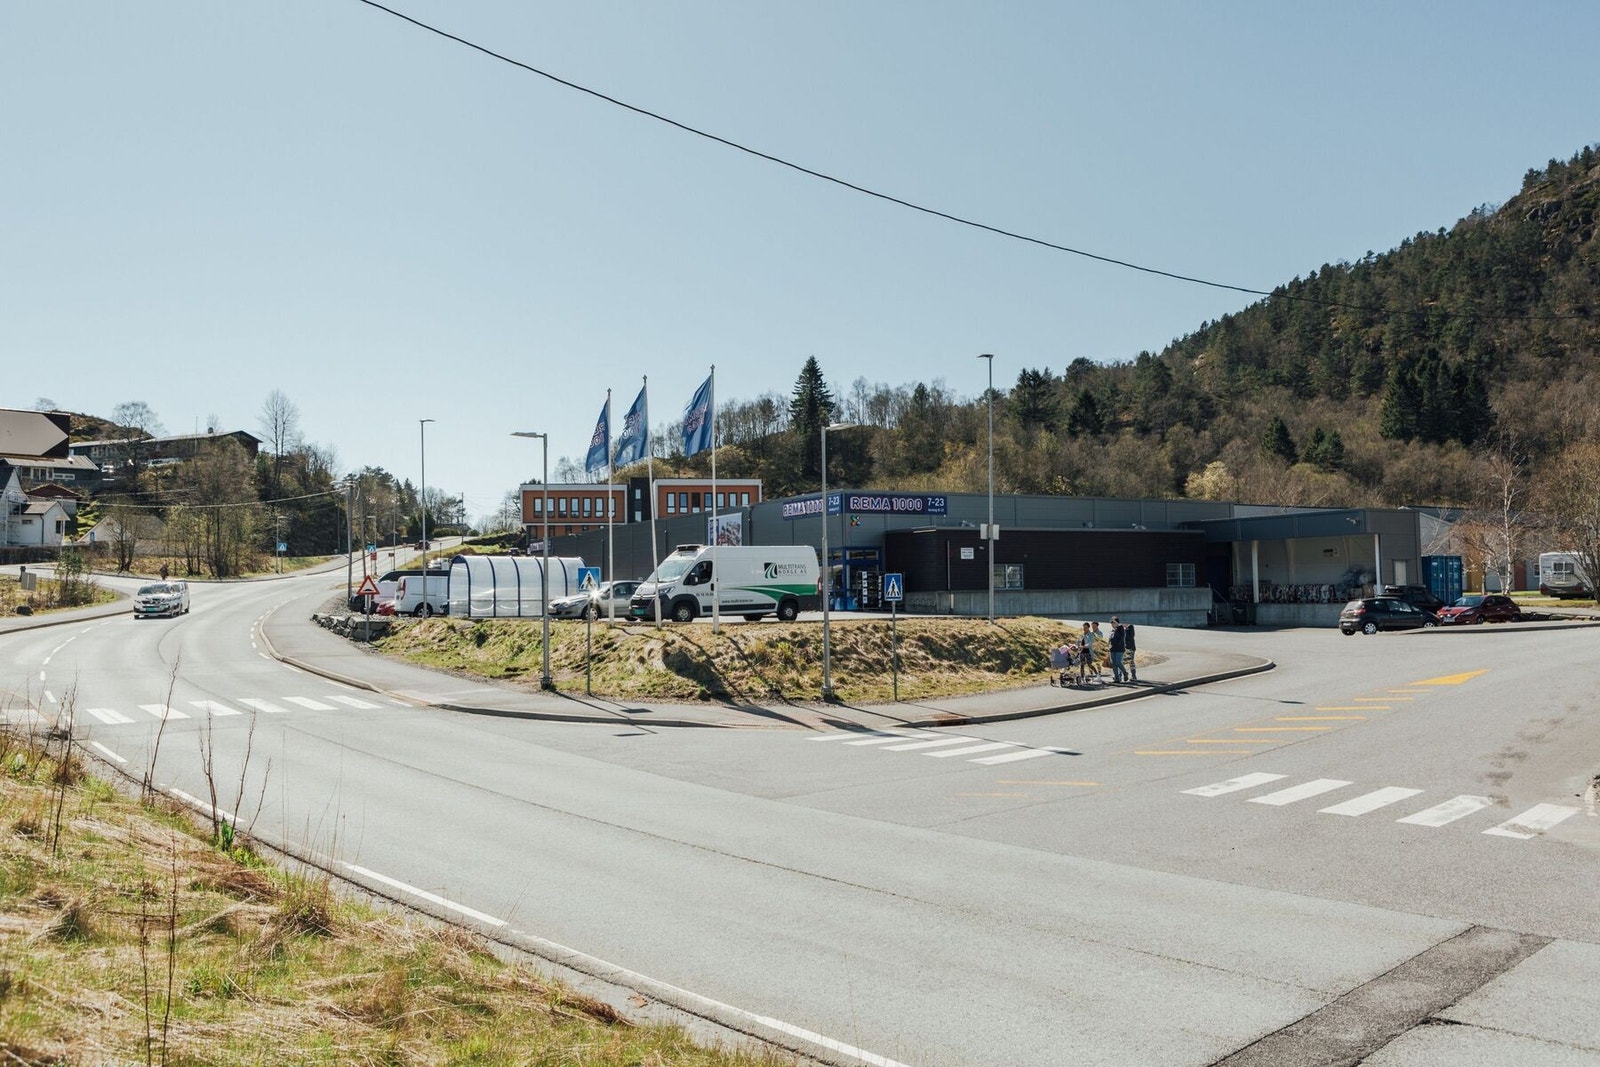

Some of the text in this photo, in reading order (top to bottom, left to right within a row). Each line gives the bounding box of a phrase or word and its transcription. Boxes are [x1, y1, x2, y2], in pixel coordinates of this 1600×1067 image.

[828, 496, 840, 506] 7-23
[850, 496, 923, 511] REMA 1000
[927, 497, 945, 507] 7-23
[782, 501, 806, 517] REMA
